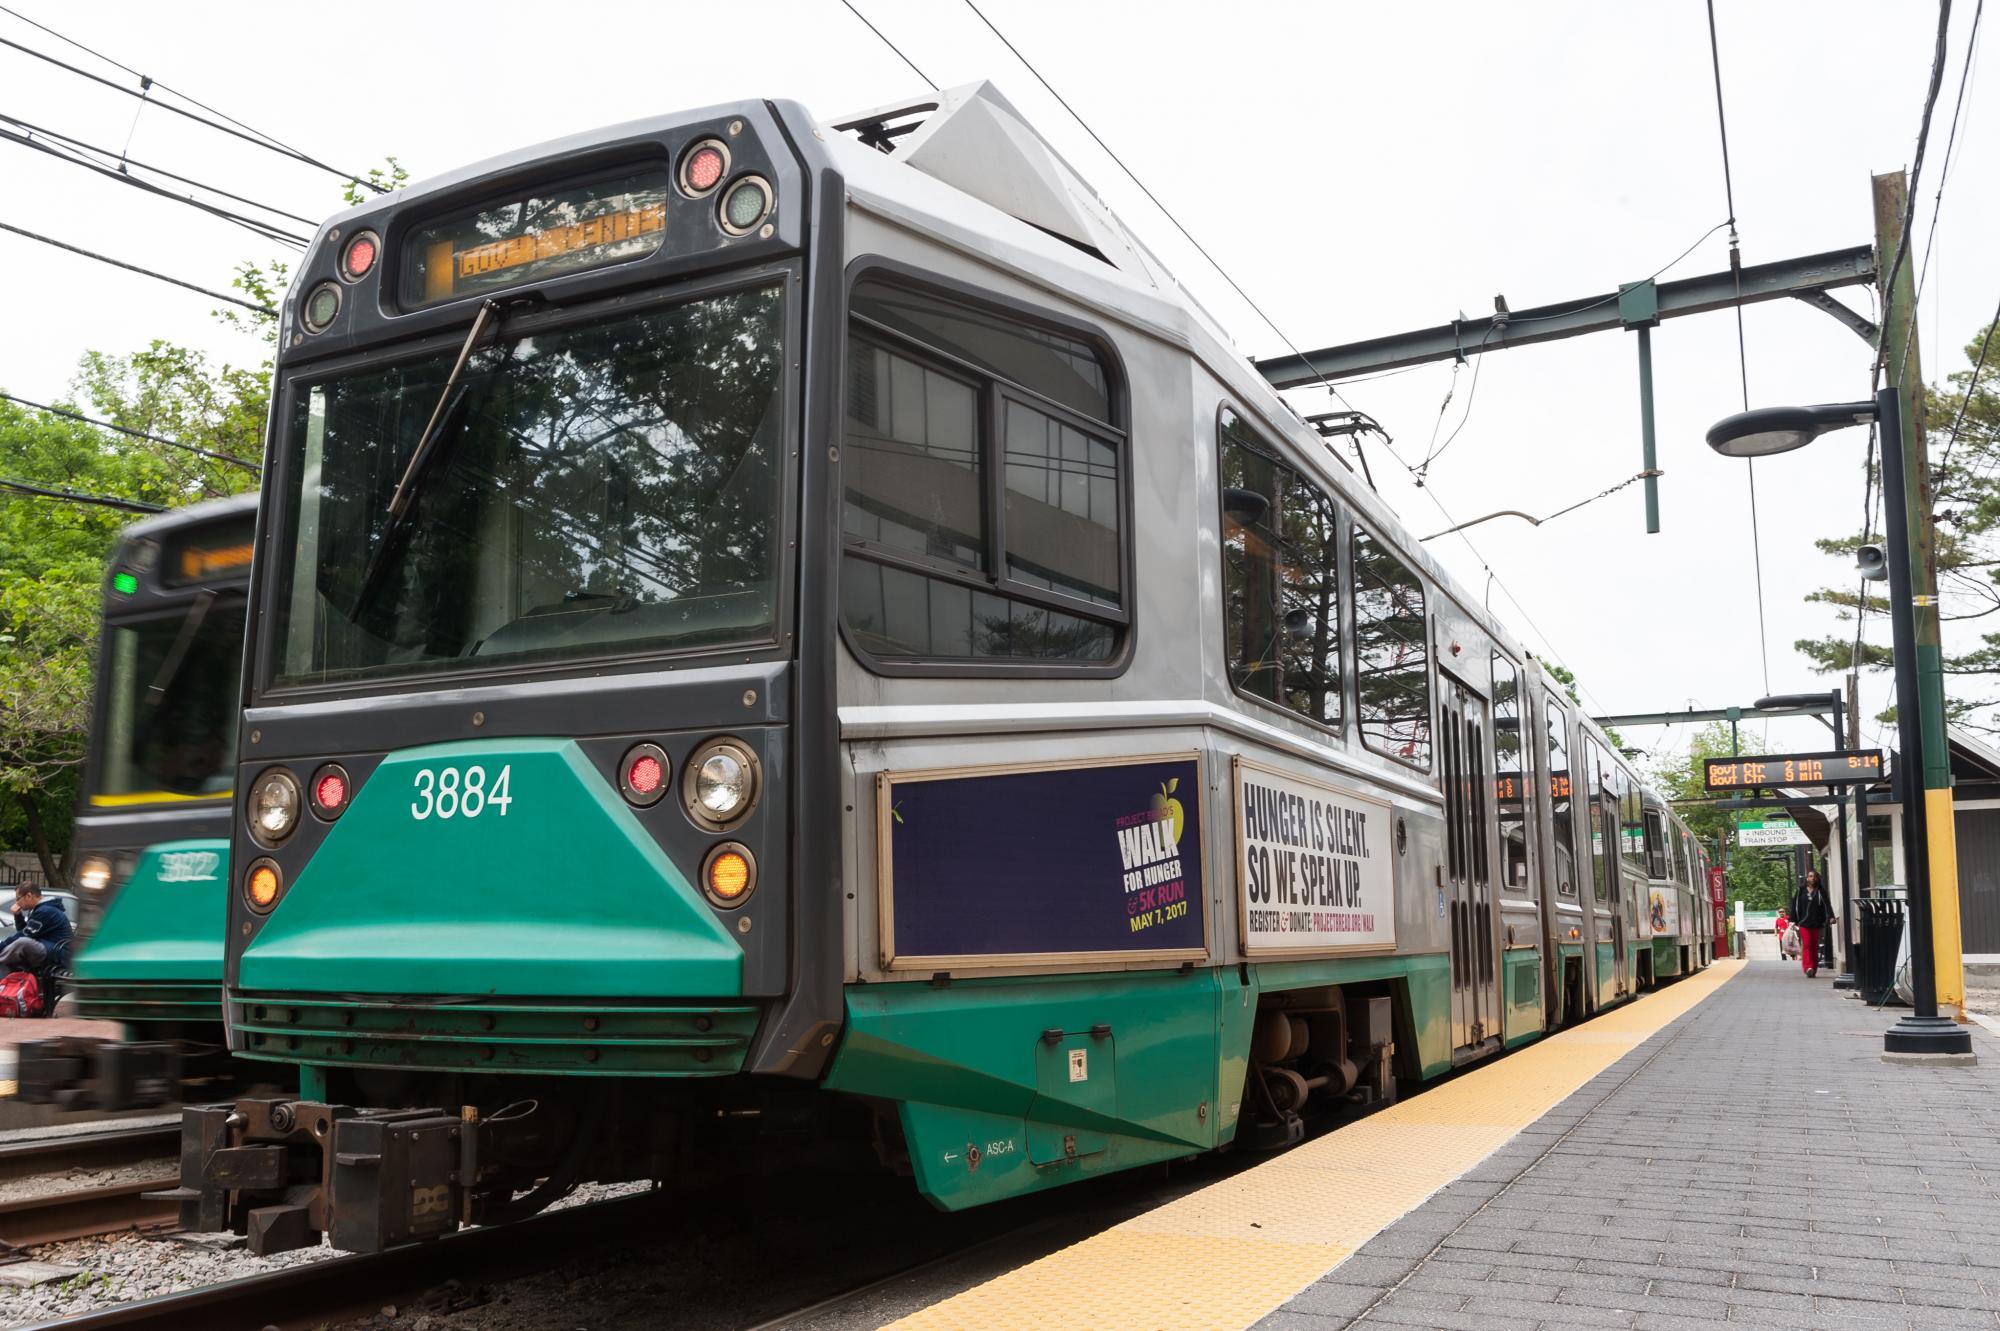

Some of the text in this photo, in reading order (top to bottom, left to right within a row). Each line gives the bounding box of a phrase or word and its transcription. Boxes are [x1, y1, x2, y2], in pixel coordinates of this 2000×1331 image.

[1709, 756, 1879, 776] Govt Ctr 2 min 5:14
[1709, 770, 1823, 786] Govt Ctr 9 min
[412, 764, 512, 820] 3884
[1146, 806, 1174, 820] BAD'S
[1244, 783, 1370, 858] HUNGER IS SILENT.
[1762, 821, 1788, 829] GREEN
[1118, 818, 1179, 870] WALK
[1124, 860, 1182, 893] FOR HUNGER
[1248, 844, 1362, 908] SO WE SPEAK UP.
[1138, 889, 1156, 912] 5K
[1158, 880, 1185, 906] RUN
[1130, 901, 1187, 932] MAY 7, 2017
[1250, 910, 1280, 932] REGISTER
[986, 1140, 1014, 1156] ASC-A
